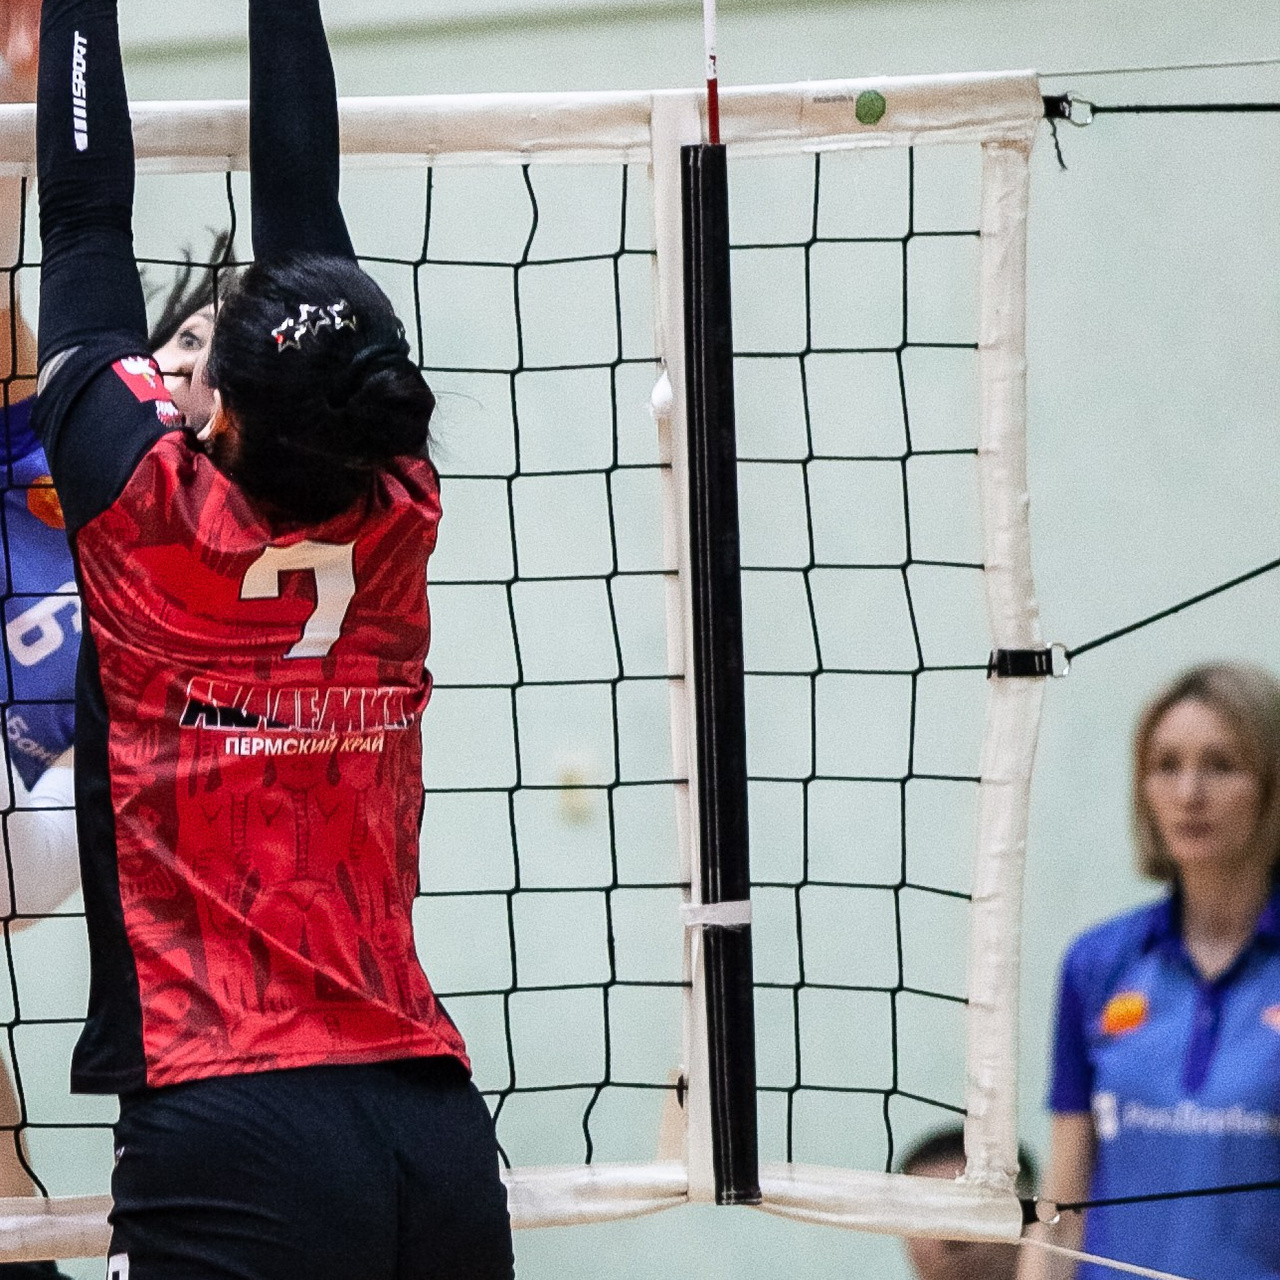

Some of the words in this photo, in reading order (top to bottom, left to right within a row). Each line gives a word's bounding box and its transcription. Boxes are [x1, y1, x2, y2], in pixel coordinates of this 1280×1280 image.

[72, 30, 88, 98] SPORT
[240, 539, 357, 660] 7
[225, 733, 337, 756] ПЕРМСКИЙ
[340, 732, 385, 753] КРАЙ
